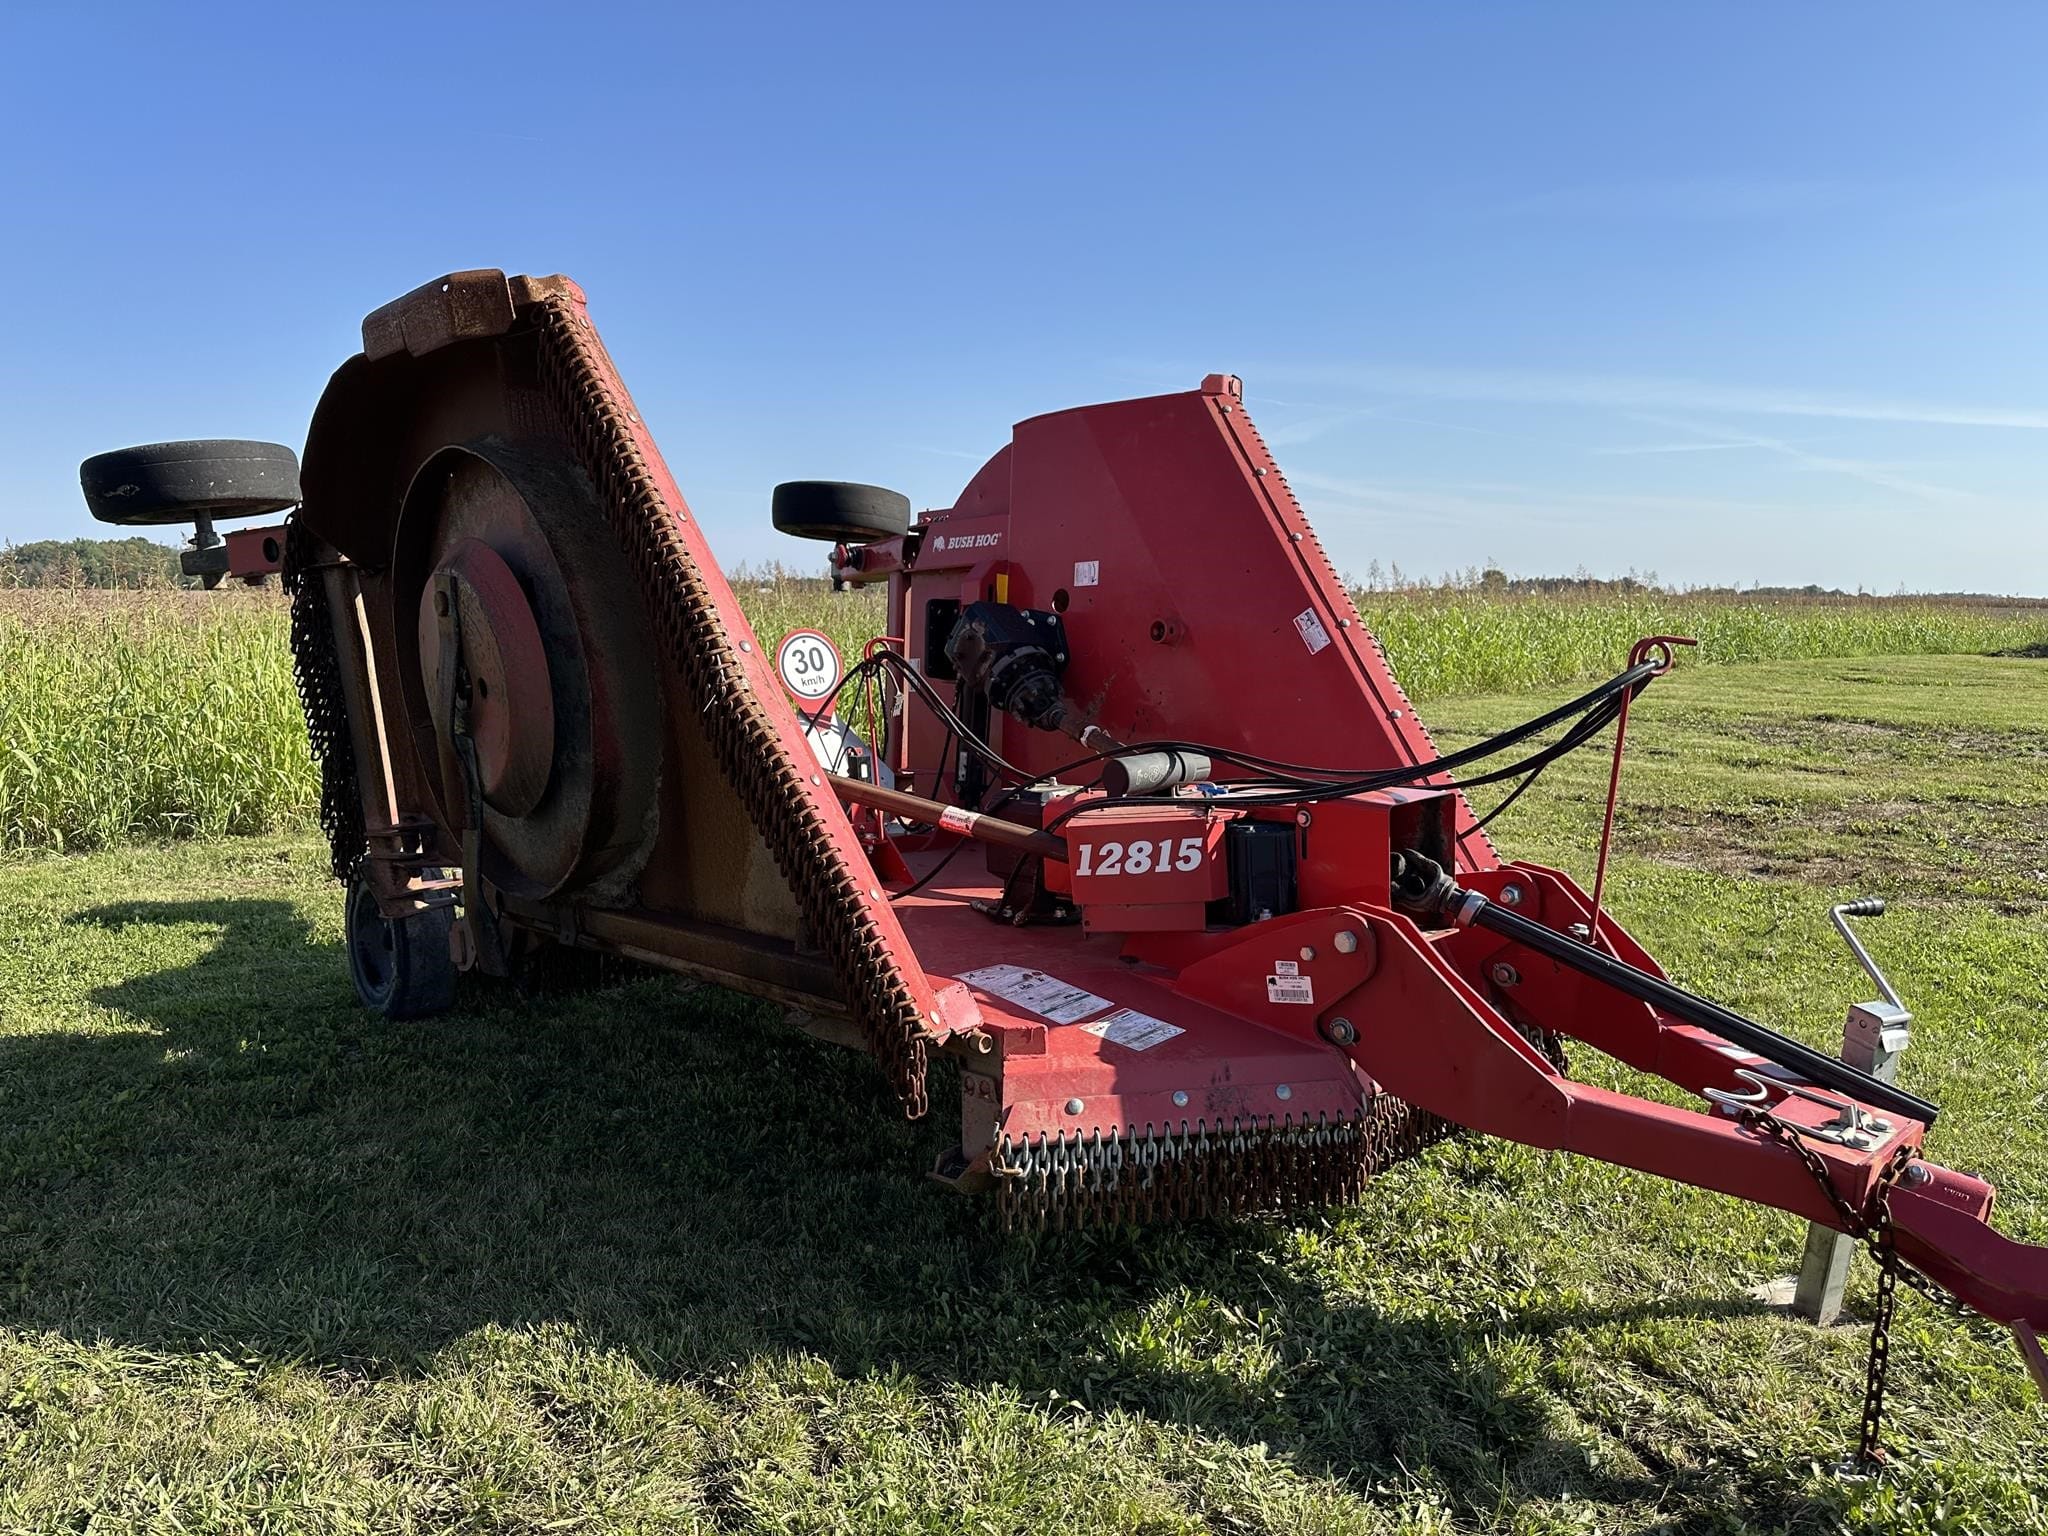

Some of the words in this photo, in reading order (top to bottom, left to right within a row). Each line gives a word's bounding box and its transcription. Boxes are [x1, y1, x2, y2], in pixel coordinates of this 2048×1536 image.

[947, 535, 975, 550] BUSH
[975, 533, 999, 547] HOG
[792, 647, 824, 674] 30
[801, 675, 825, 687] km/h
[1076, 837, 1203, 876] 12815
